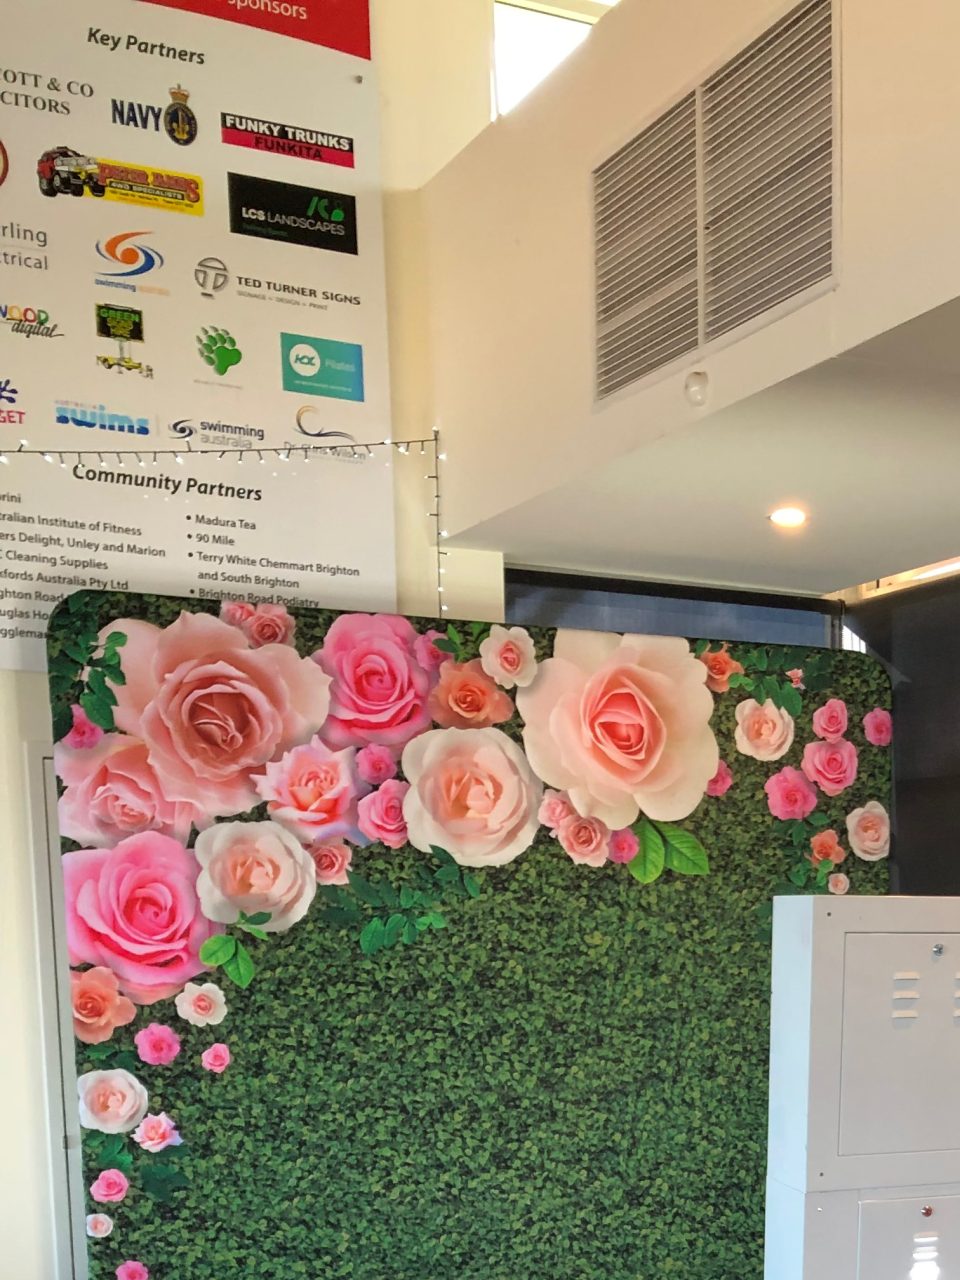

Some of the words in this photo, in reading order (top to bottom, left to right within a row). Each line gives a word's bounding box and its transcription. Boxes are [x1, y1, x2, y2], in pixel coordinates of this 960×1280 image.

[228, 0, 307, 20] ponsors
[87, 27, 121, 51] Key
[125, 35, 205, 65] Partners
[0, 68, 42, 88] OTT
[47, 77, 61, 92] &
[67, 81, 94, 97] CO
[111, 98, 162, 132] NAVY
[225, 115, 281, 136] FUNKY
[285, 127, 350, 151] TRUNKS
[254, 136, 323, 160] FUNKITA
[241, 207, 266, 221] LCS
[267, 212, 345, 236] LANDSCAPES
[0, 250, 49, 270] trical
[236, 276, 262, 289] TED
[266, 281, 317, 298] TURNER
[322, 291, 361, 306] SIGNS
[11, 320, 65, 338] digital
[56, 404, 149, 436] swims
[200, 420, 265, 440] swimming
[200, 433, 253, 449] australia
[73, 463, 182, 495] Community
[186, 478, 262, 501] Partners
[38, 515, 86, 530] Institute
[89, 521, 101, 531] of
[103, 523, 142, 536] Fitness
[195, 514, 236, 528] Madura
[238, 519, 256, 531] Tea
[19, 532, 64, 547] Delight,
[67, 538, 99, 552] Unley
[102, 543, 124, 553] and
[127, 544, 166, 557] Marion
[196, 533, 210, 544] 90
[212, 535, 235, 546] Mile
[6, 550, 57, 567] Cleaning
[60, 557, 109, 570] Supplies
[197, 551, 224, 565] Terry
[226, 555, 257, 567] White
[259, 558, 314, 572] Chemmart
[316, 564, 360, 577] Brighton
[36, 572, 86, 587] Australia
[89, 577, 107, 591] Pty
[111, 580, 129, 590] Ltd
[198, 571, 218, 582] and
[220, 573, 252, 585] South
[254, 575, 300, 589] Brighton
[198, 588, 245, 602] Brighton
[247, 592, 275, 604] Road
